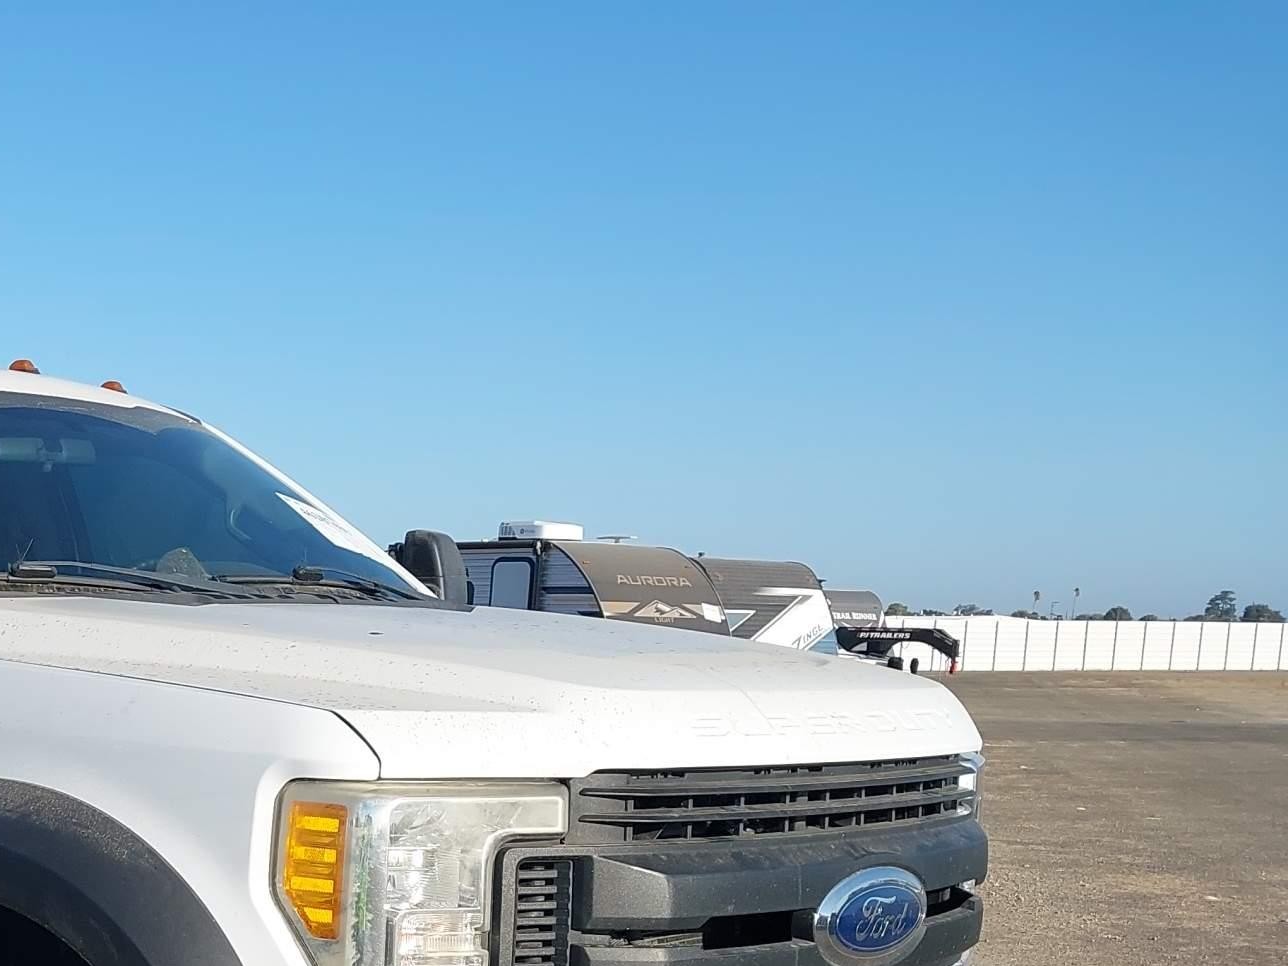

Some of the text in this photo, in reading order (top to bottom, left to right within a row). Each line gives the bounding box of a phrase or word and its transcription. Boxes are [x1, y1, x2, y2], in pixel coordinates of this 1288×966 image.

[616, 574, 692, 588] AURORA
[832, 611, 878, 621] TRAIL RUNNER
[869, 632, 911, 640] TRAILERS
[855, 895, 910, 941] Ford
